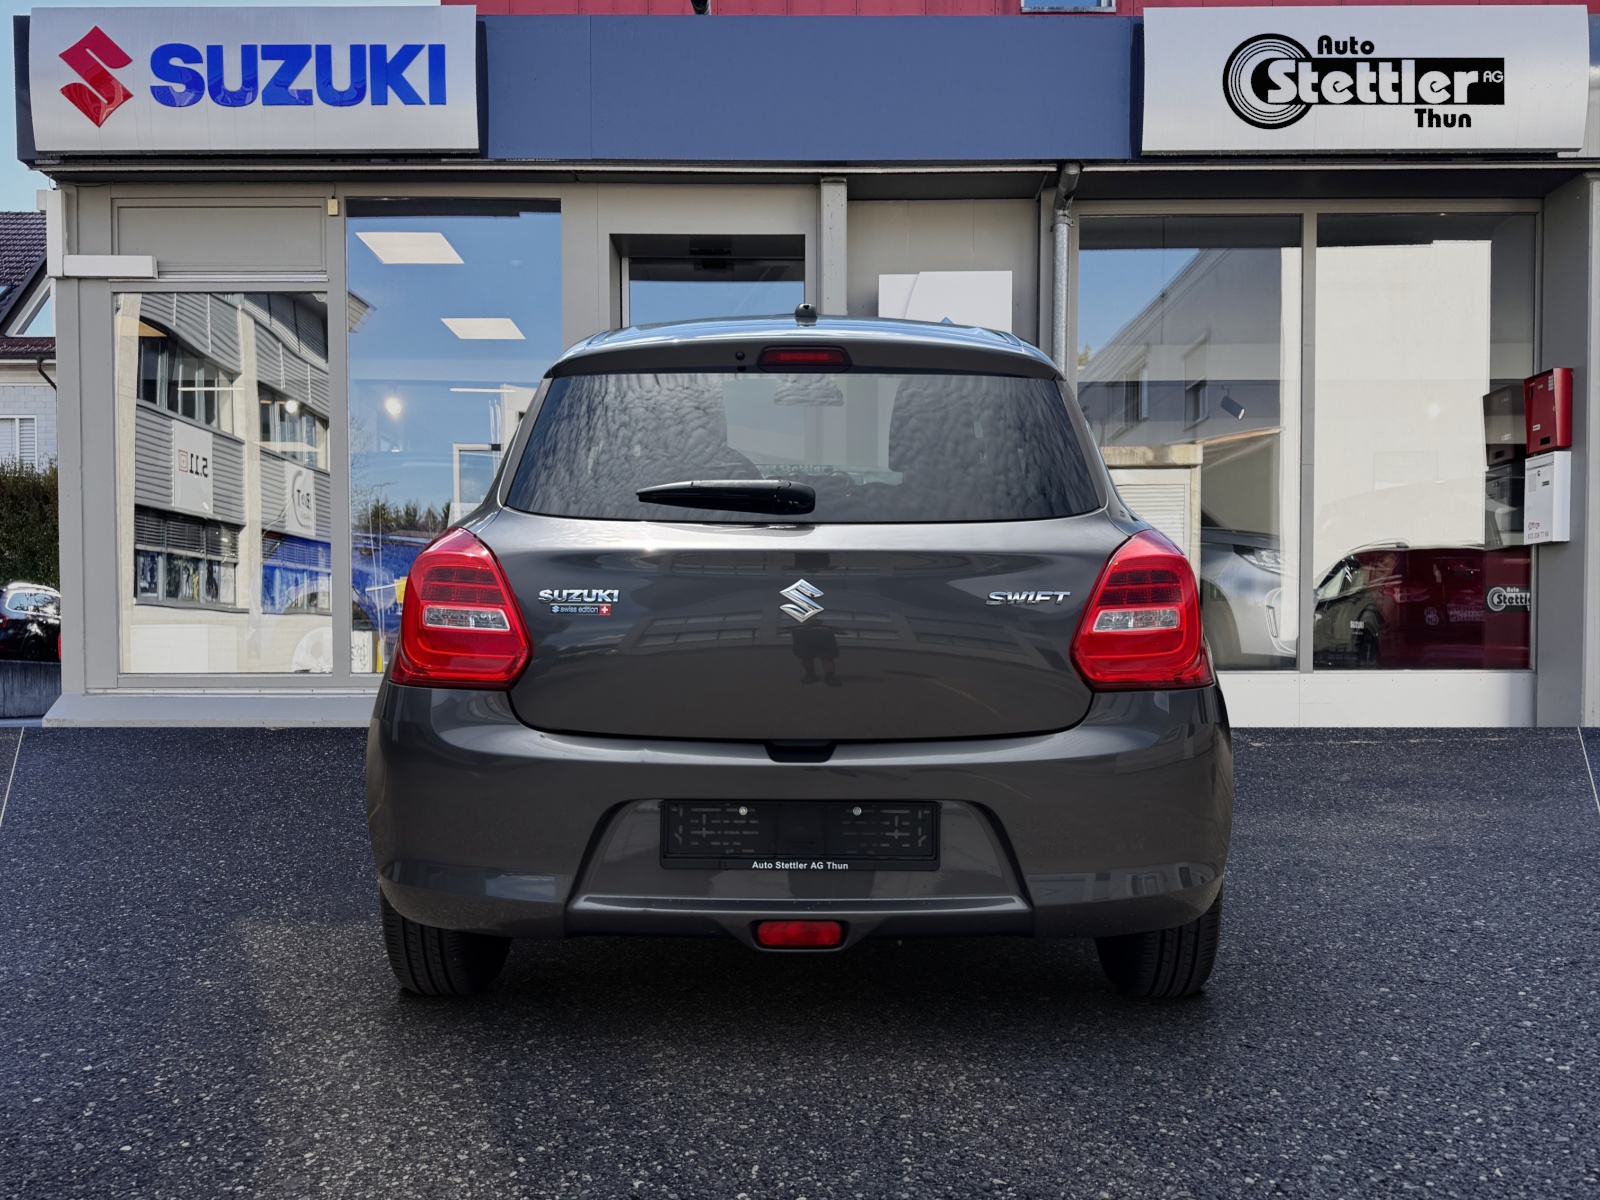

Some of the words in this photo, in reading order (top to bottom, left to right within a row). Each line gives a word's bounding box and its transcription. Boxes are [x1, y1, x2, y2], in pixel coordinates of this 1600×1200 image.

[1317, 35, 1375, 55] Auto
[150, 43, 447, 107] SUZUKI
[1267, 59, 1479, 104] Stettler
[1483, 70, 1504, 83] AG
[1414, 108, 1472, 128] Thun
[538, 589, 620, 603] SUZUKI
[986, 591, 1071, 605] SWIFT
[578, 605, 599, 613] edition
[752, 861, 773, 869] Auto
[775, 861, 808, 870] Stettler
[810, 861, 824, 870] AG
[826, 861, 849, 870] Thun
